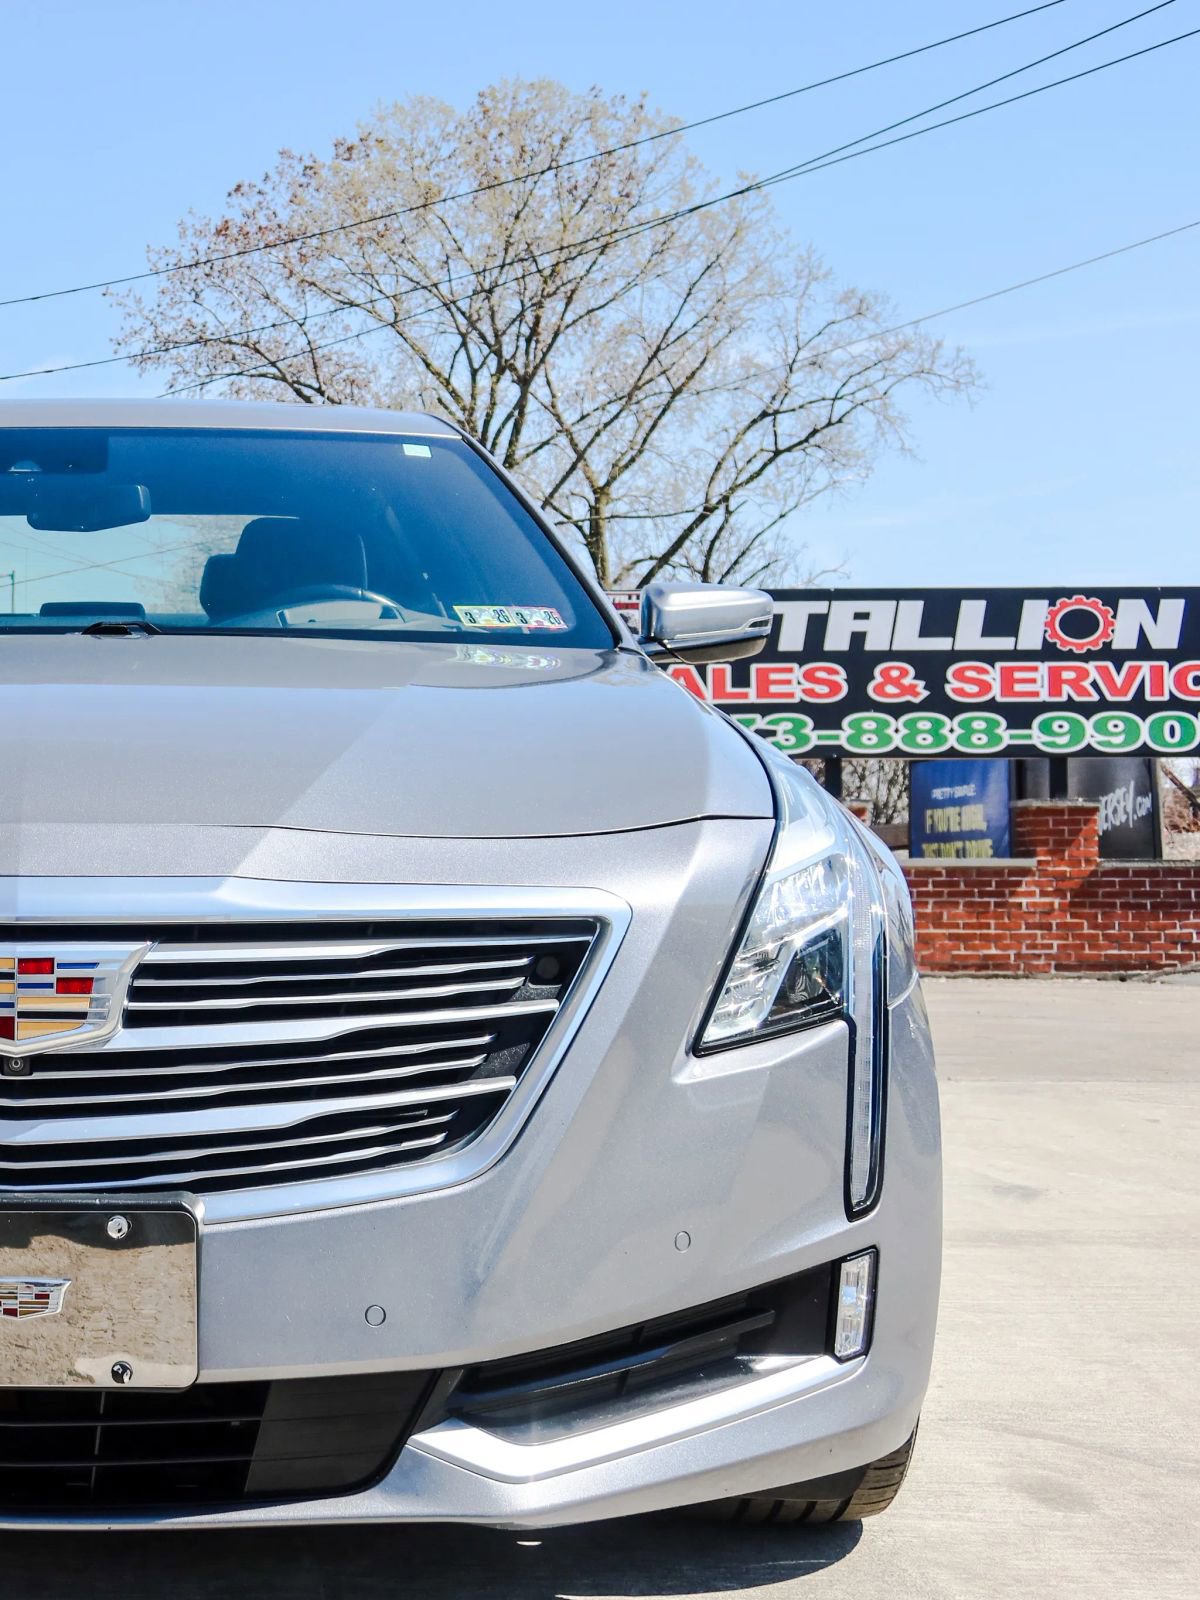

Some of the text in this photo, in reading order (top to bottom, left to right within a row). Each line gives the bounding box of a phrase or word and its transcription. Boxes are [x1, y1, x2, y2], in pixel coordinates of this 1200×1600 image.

[773, 595, 1186, 653] TALLION
[667, 660, 1200, 703] ALES & SERVIC
[730, 711, 1200, 754] 3-888-990
